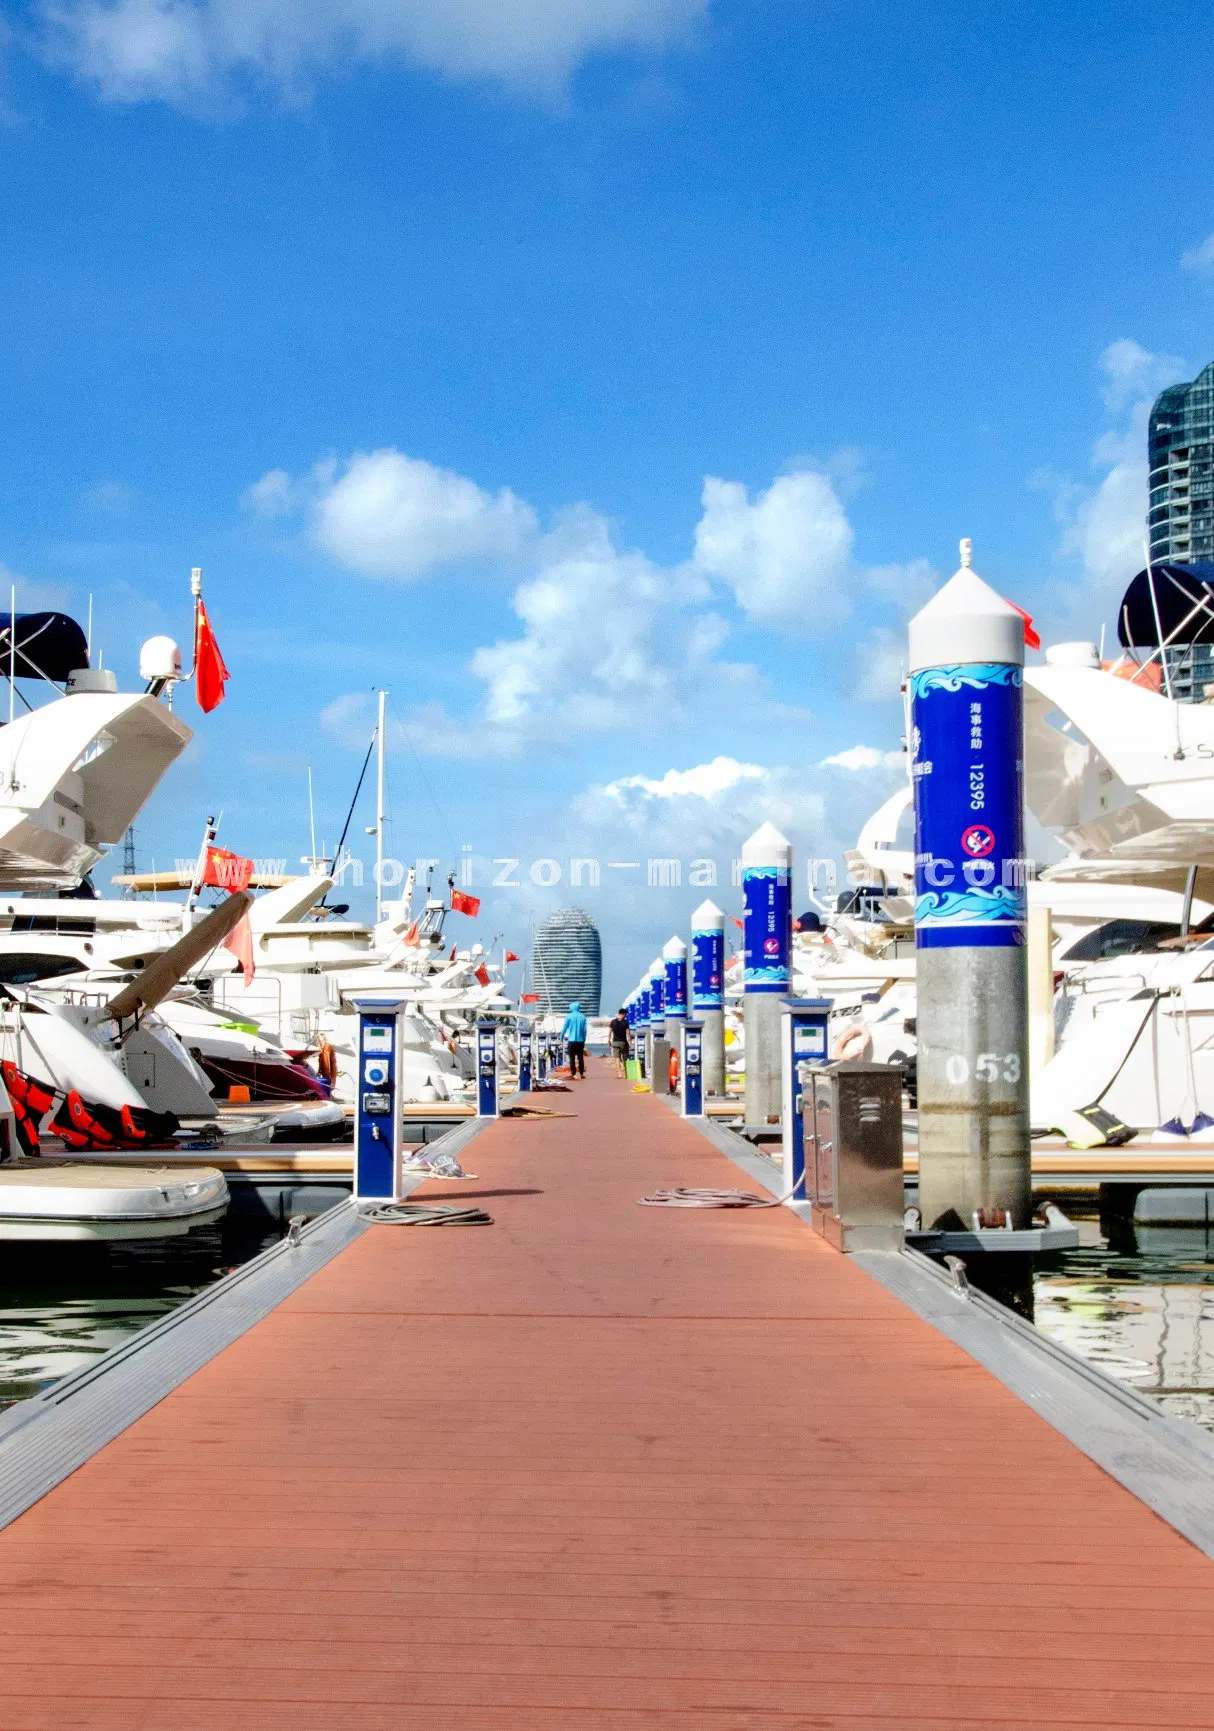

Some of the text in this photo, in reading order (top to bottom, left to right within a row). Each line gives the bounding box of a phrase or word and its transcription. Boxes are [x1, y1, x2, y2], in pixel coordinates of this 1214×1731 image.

[970, 702, 985, 810] 海事救助 12395
[946, 1053, 1021, 1085] 053
